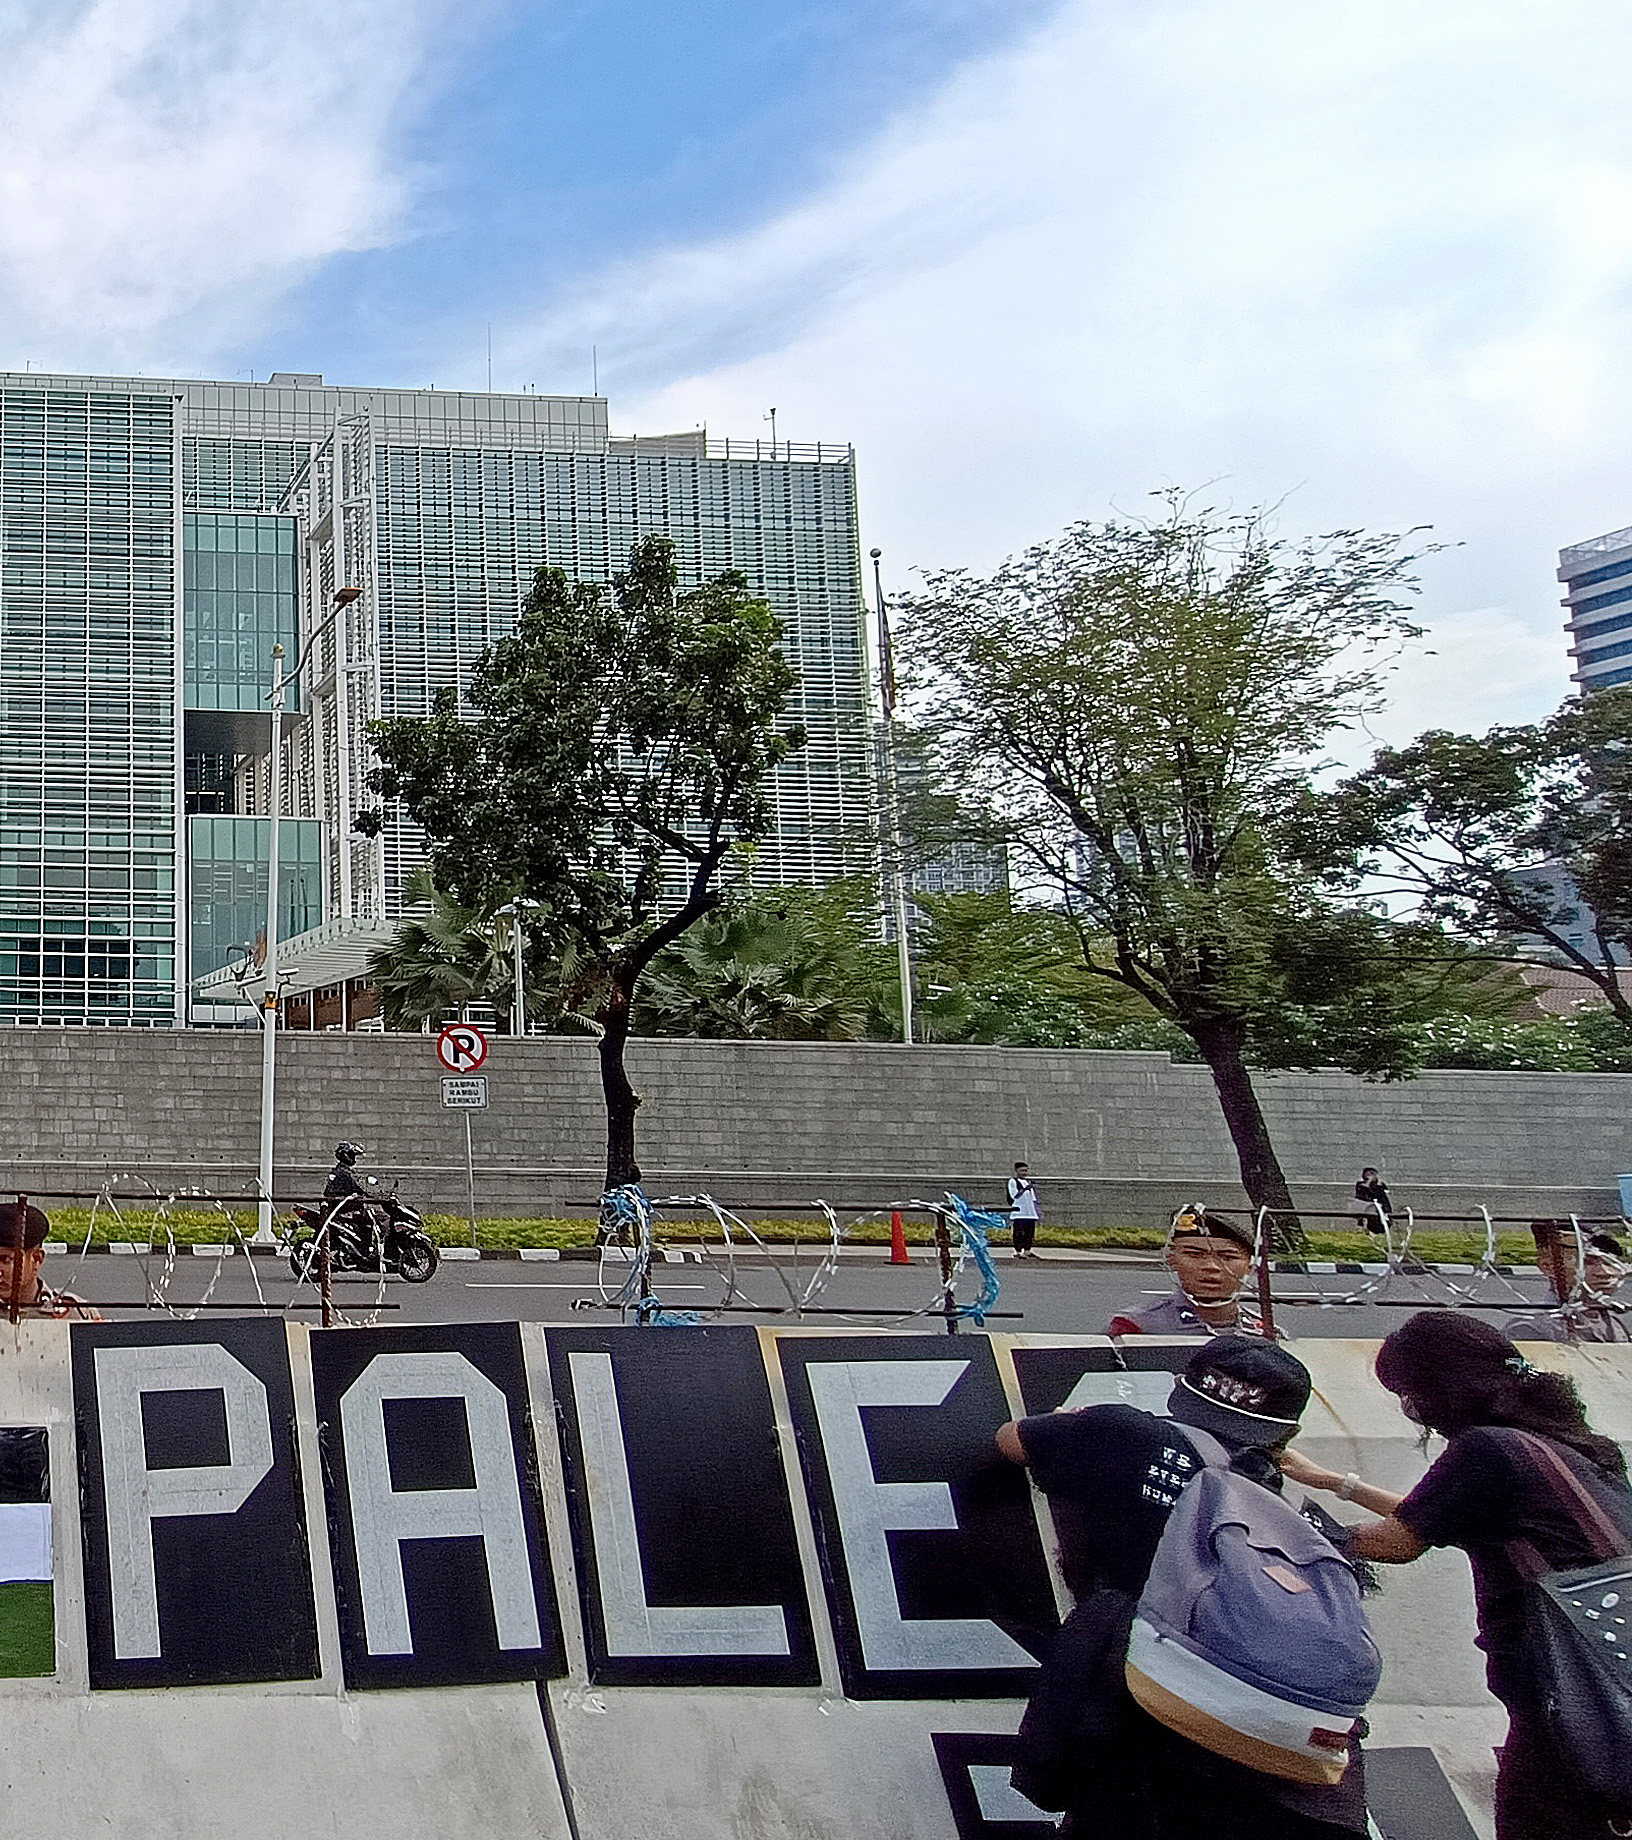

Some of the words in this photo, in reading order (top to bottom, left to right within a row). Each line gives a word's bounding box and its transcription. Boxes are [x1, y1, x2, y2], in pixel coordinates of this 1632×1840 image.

[452, 1034, 475, 1064] P
[449, 1081, 479, 1089] SAMPAI
[447, 1097, 481, 1105] BERIKUT
[93, 1342, 1175, 1672] PALE
